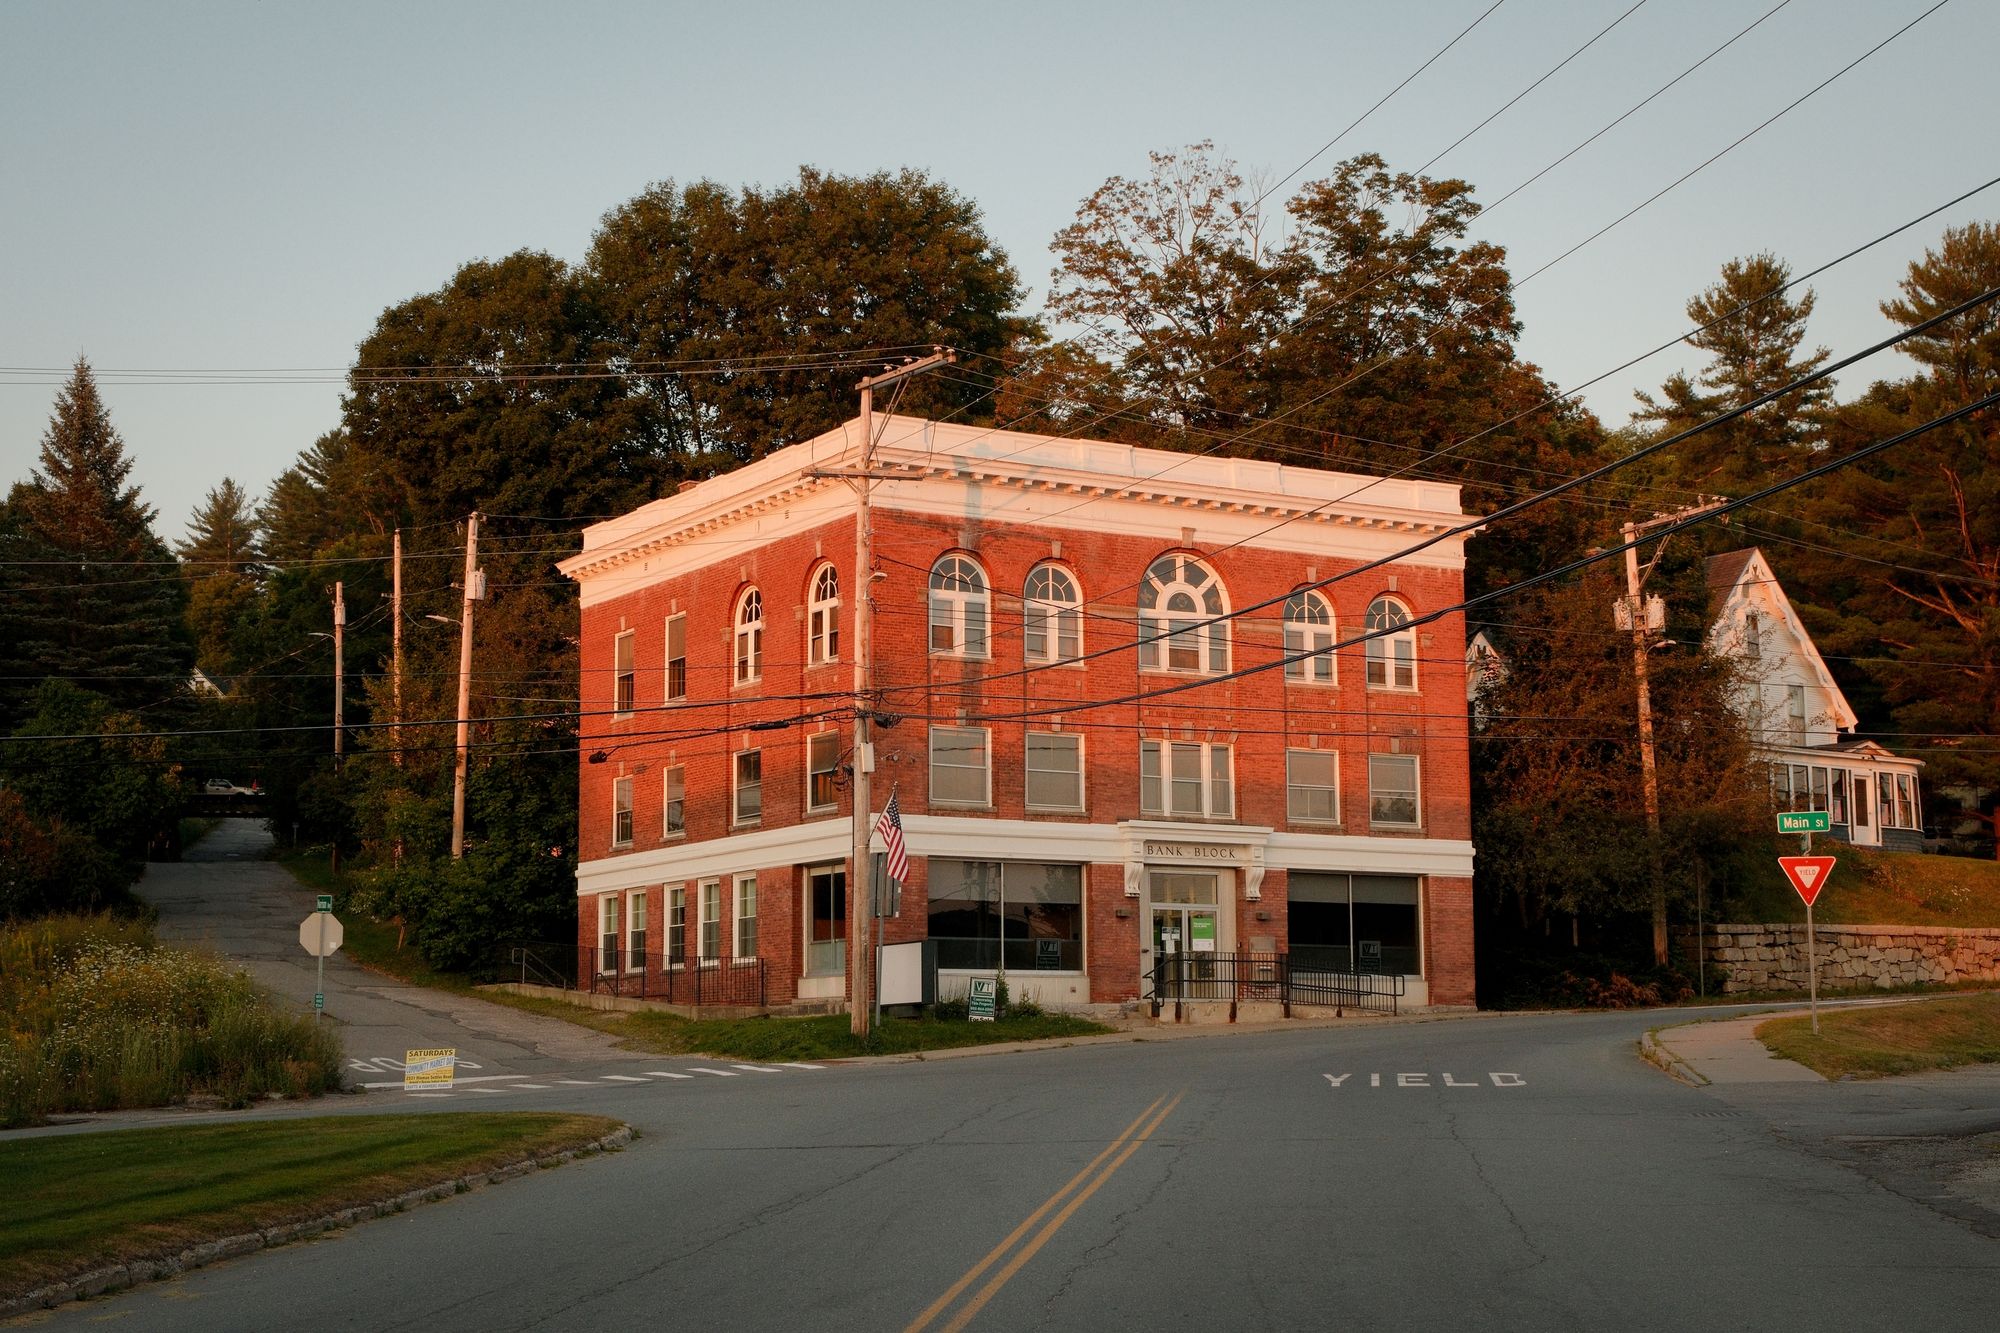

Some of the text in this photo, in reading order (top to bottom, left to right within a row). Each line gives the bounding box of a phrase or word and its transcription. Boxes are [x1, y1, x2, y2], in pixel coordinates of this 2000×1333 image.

[1784, 817, 1809, 828] Main
[1147, 845, 1236, 859] BANK BLOCK
[974, 981, 993, 991] VT
[1322, 1072, 1528, 1087] YIELD
